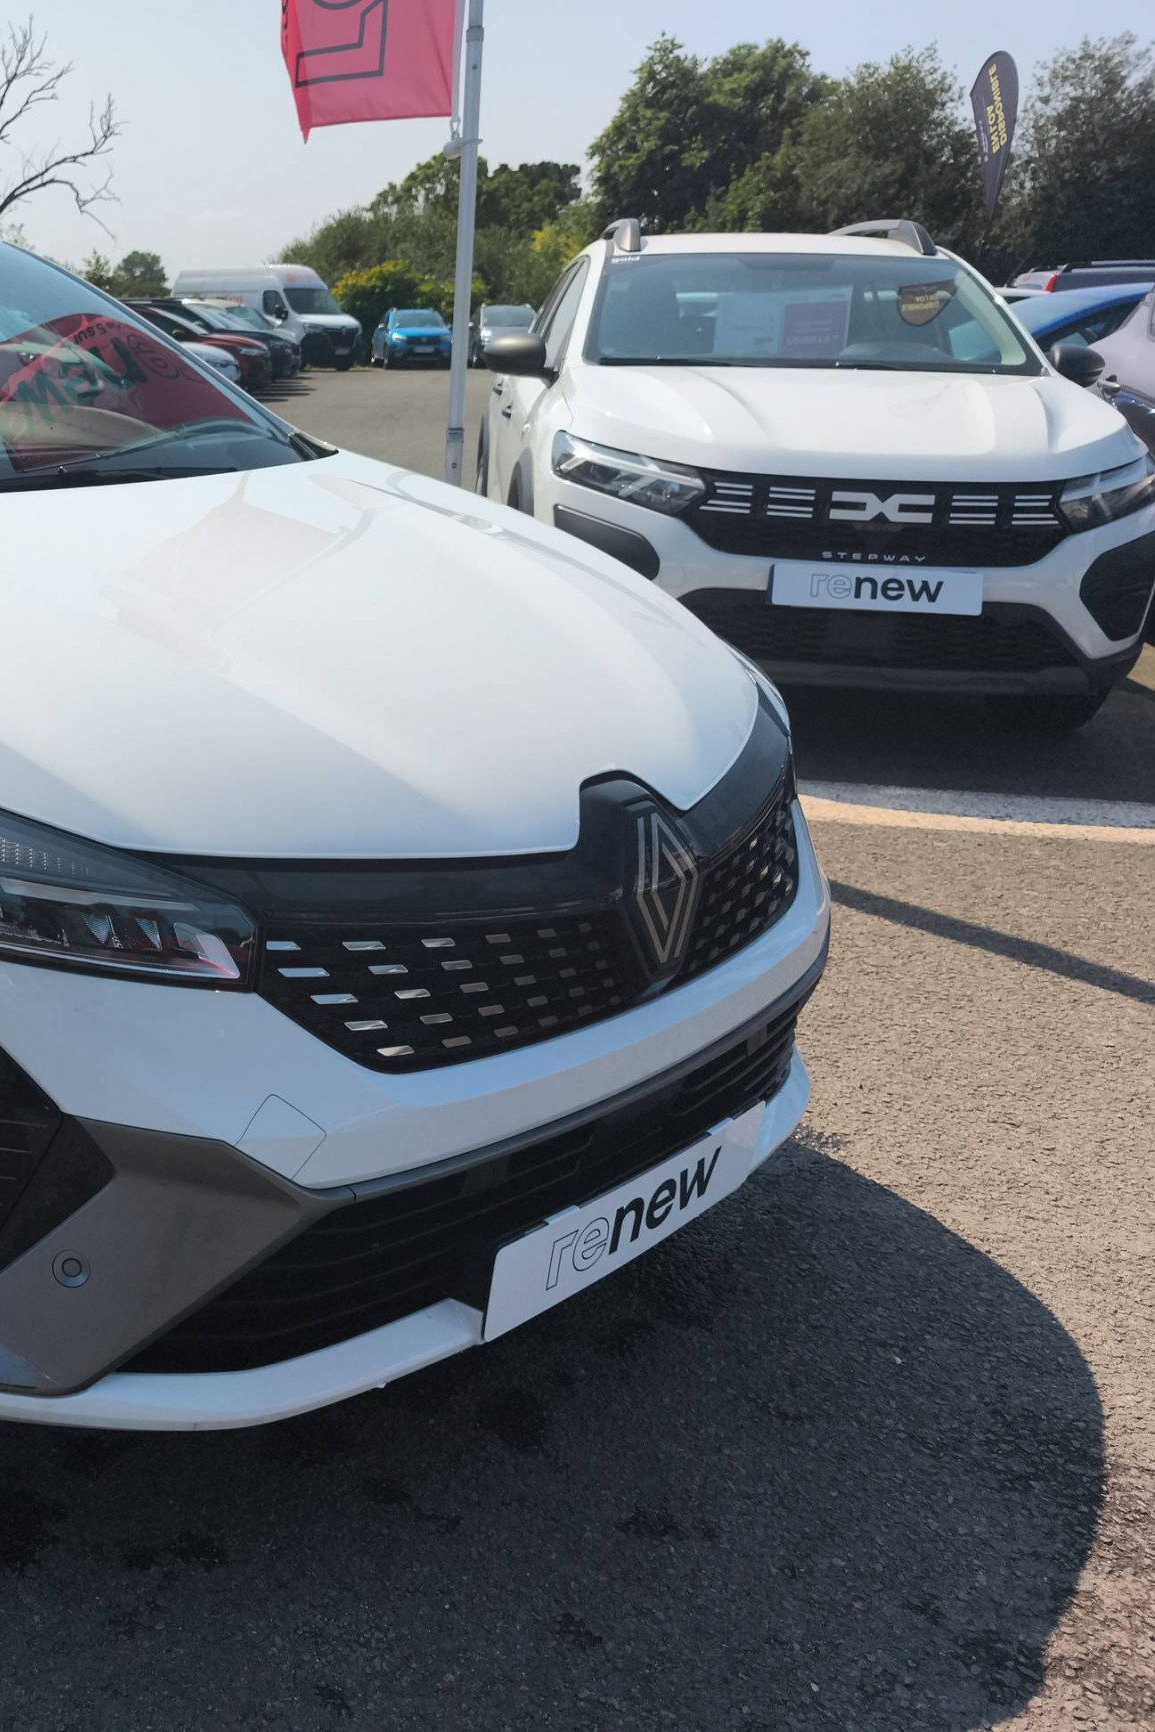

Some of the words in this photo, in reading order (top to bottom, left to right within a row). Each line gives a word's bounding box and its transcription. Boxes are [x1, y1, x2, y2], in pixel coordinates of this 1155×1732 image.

[821, 551, 926, 563] STEPWAY
[809, 573, 945, 603] renew
[545, 1145, 723, 1292] renew
